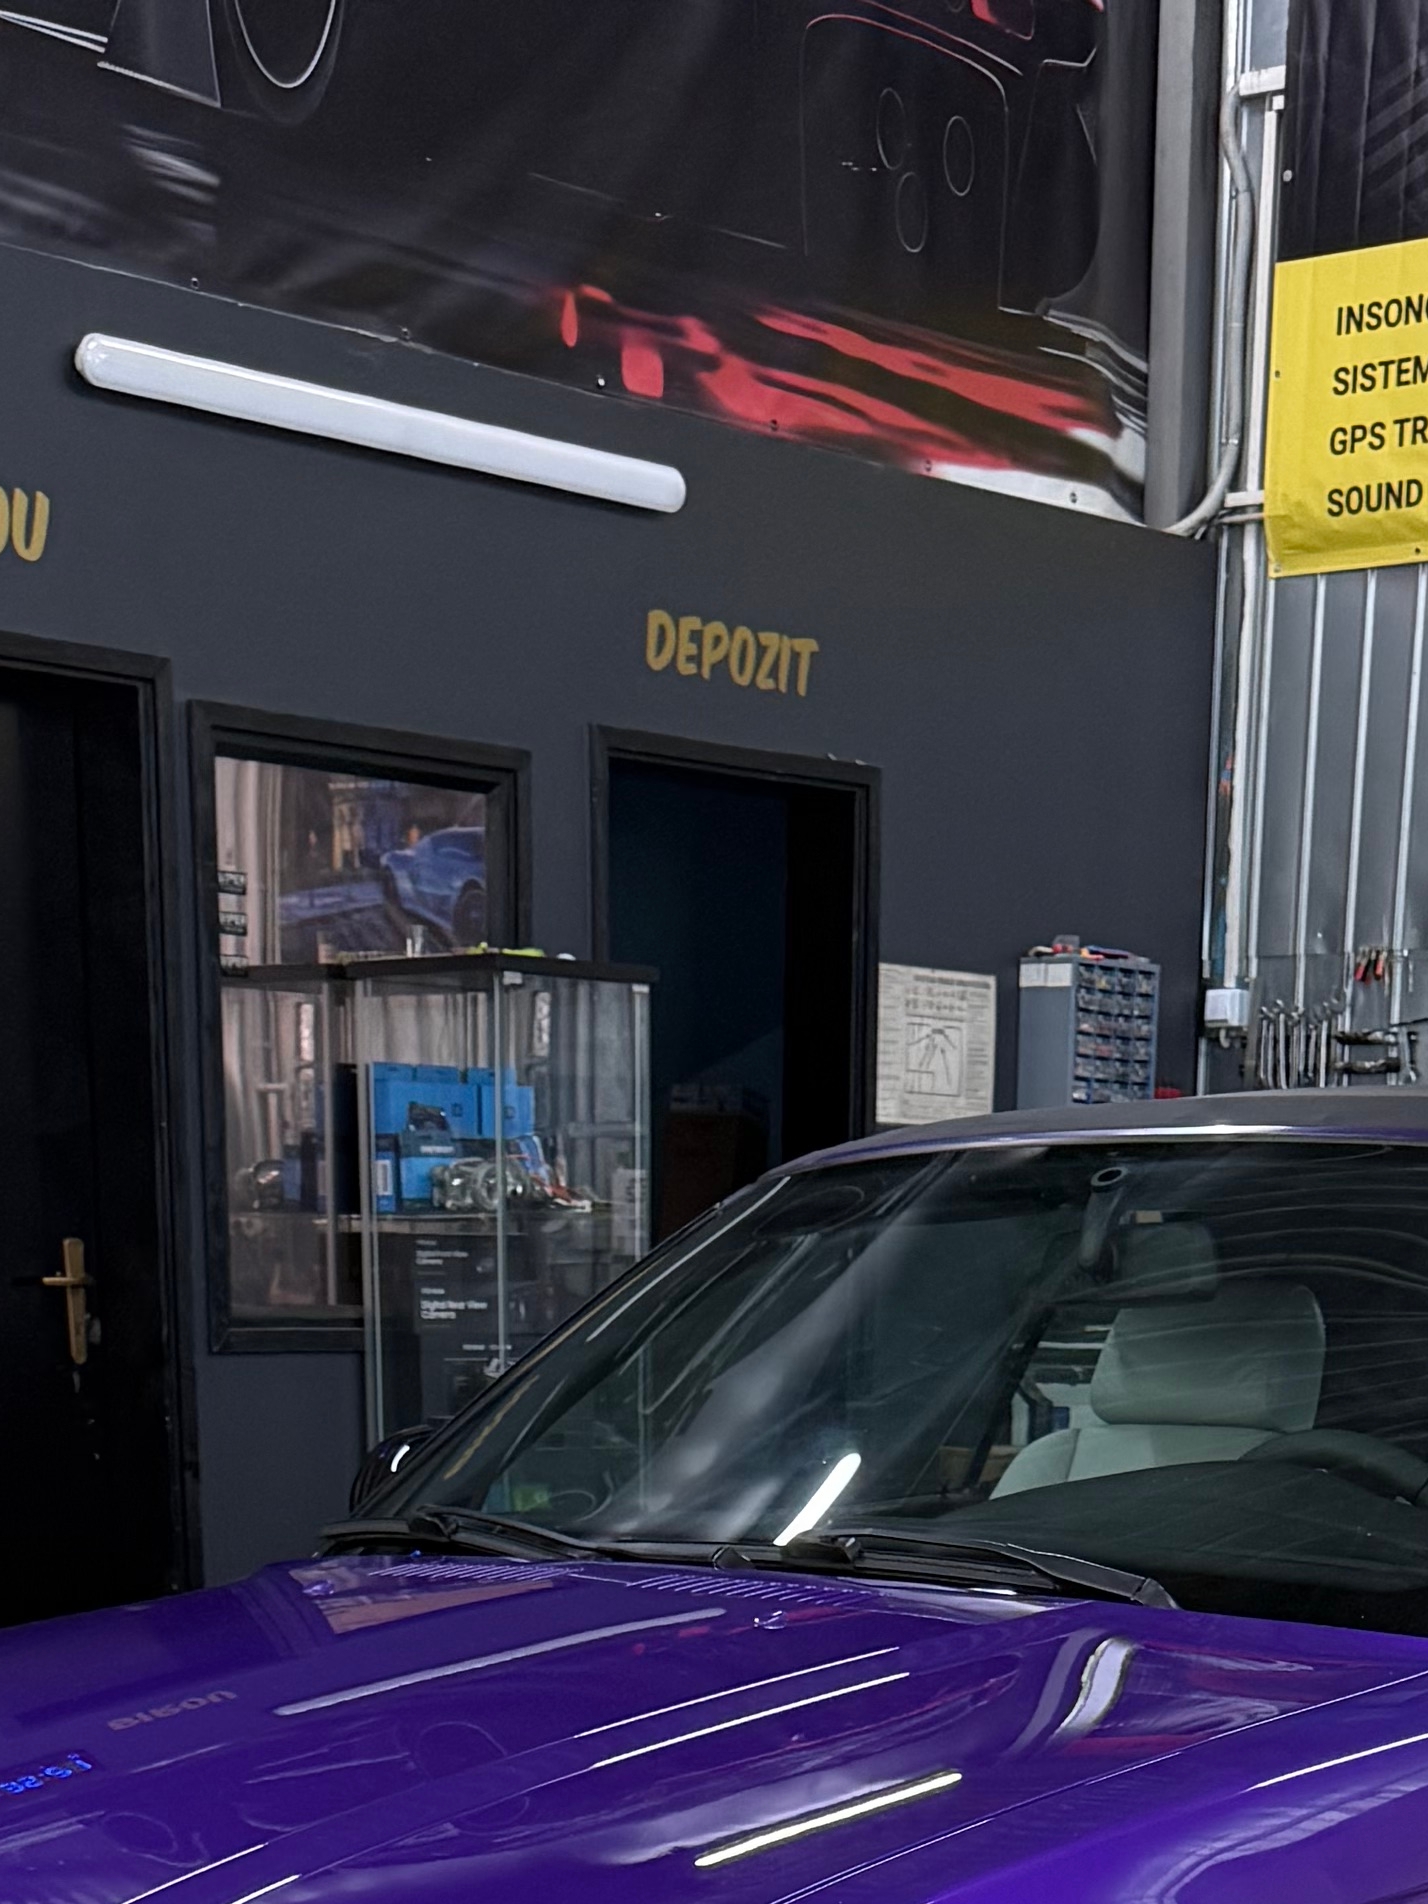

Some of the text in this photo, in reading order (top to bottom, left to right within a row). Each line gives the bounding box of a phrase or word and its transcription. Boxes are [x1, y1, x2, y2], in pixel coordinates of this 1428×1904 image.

[1330, 421, 1386, 455] GPS
[1327, 478, 1422, 517] SOUND
[646, 609, 820, 697] DEPOZIT
